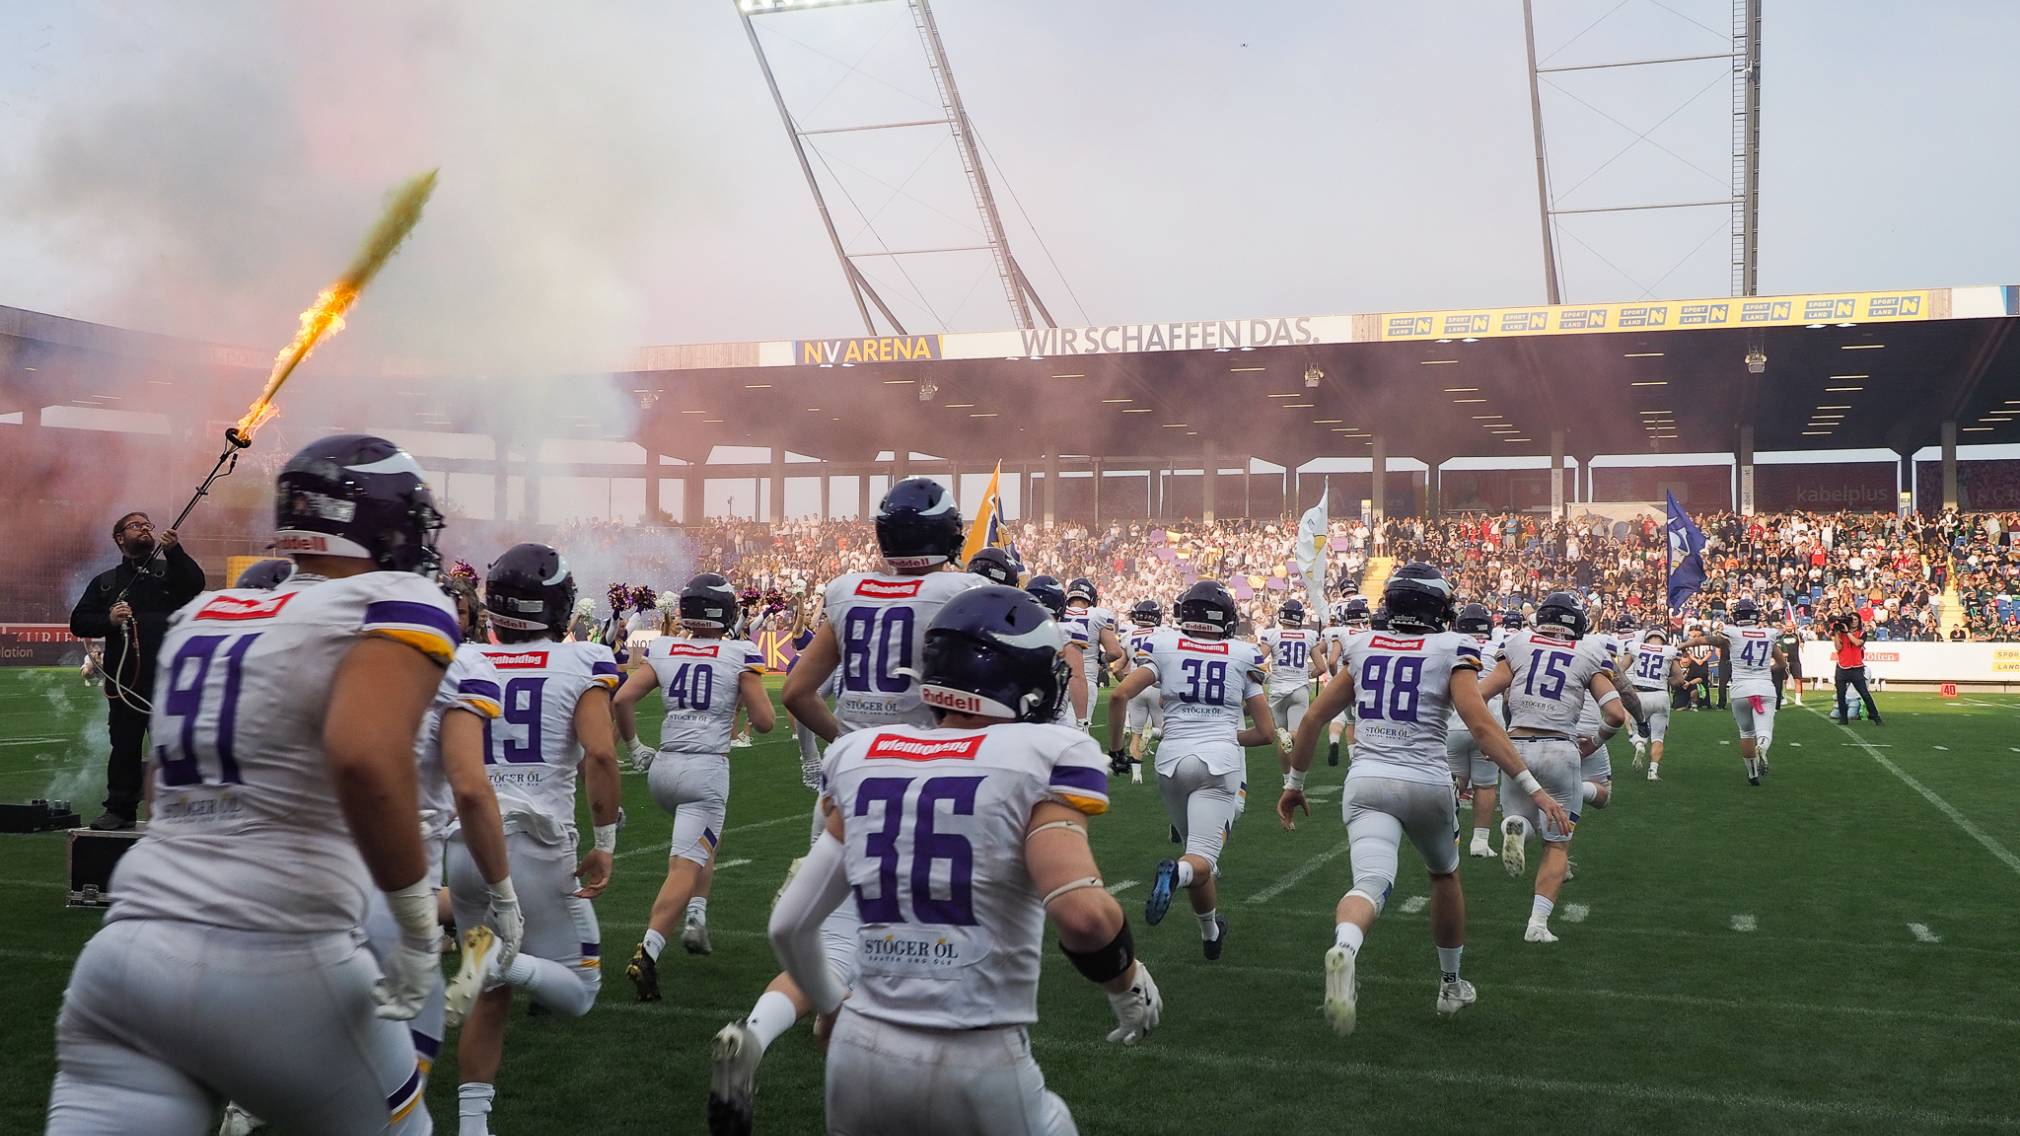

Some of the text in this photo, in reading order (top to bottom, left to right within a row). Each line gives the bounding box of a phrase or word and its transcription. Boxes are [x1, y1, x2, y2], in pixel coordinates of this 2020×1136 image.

[804, 336, 931, 364] NV ARENA
[1021, 316, 1320, 356] WIR SCHAFFEN DAS.
[1796, 483, 1889, 506] kabelplus
[844, 606, 915, 693] 80
[1278, 641, 1306, 668] 30
[1636, 652, 1665, 680] 32
[1740, 640, 1770, 667] 47
[668, 662, 713, 711] 40
[1179, 658, 1229, 706] 38
[1358, 655, 1428, 722] 98
[1524, 648, 1575, 701] 15
[1944, 684, 1956, 697] 40
[156, 632, 265, 786] 91
[854, 776, 989, 927] 36
